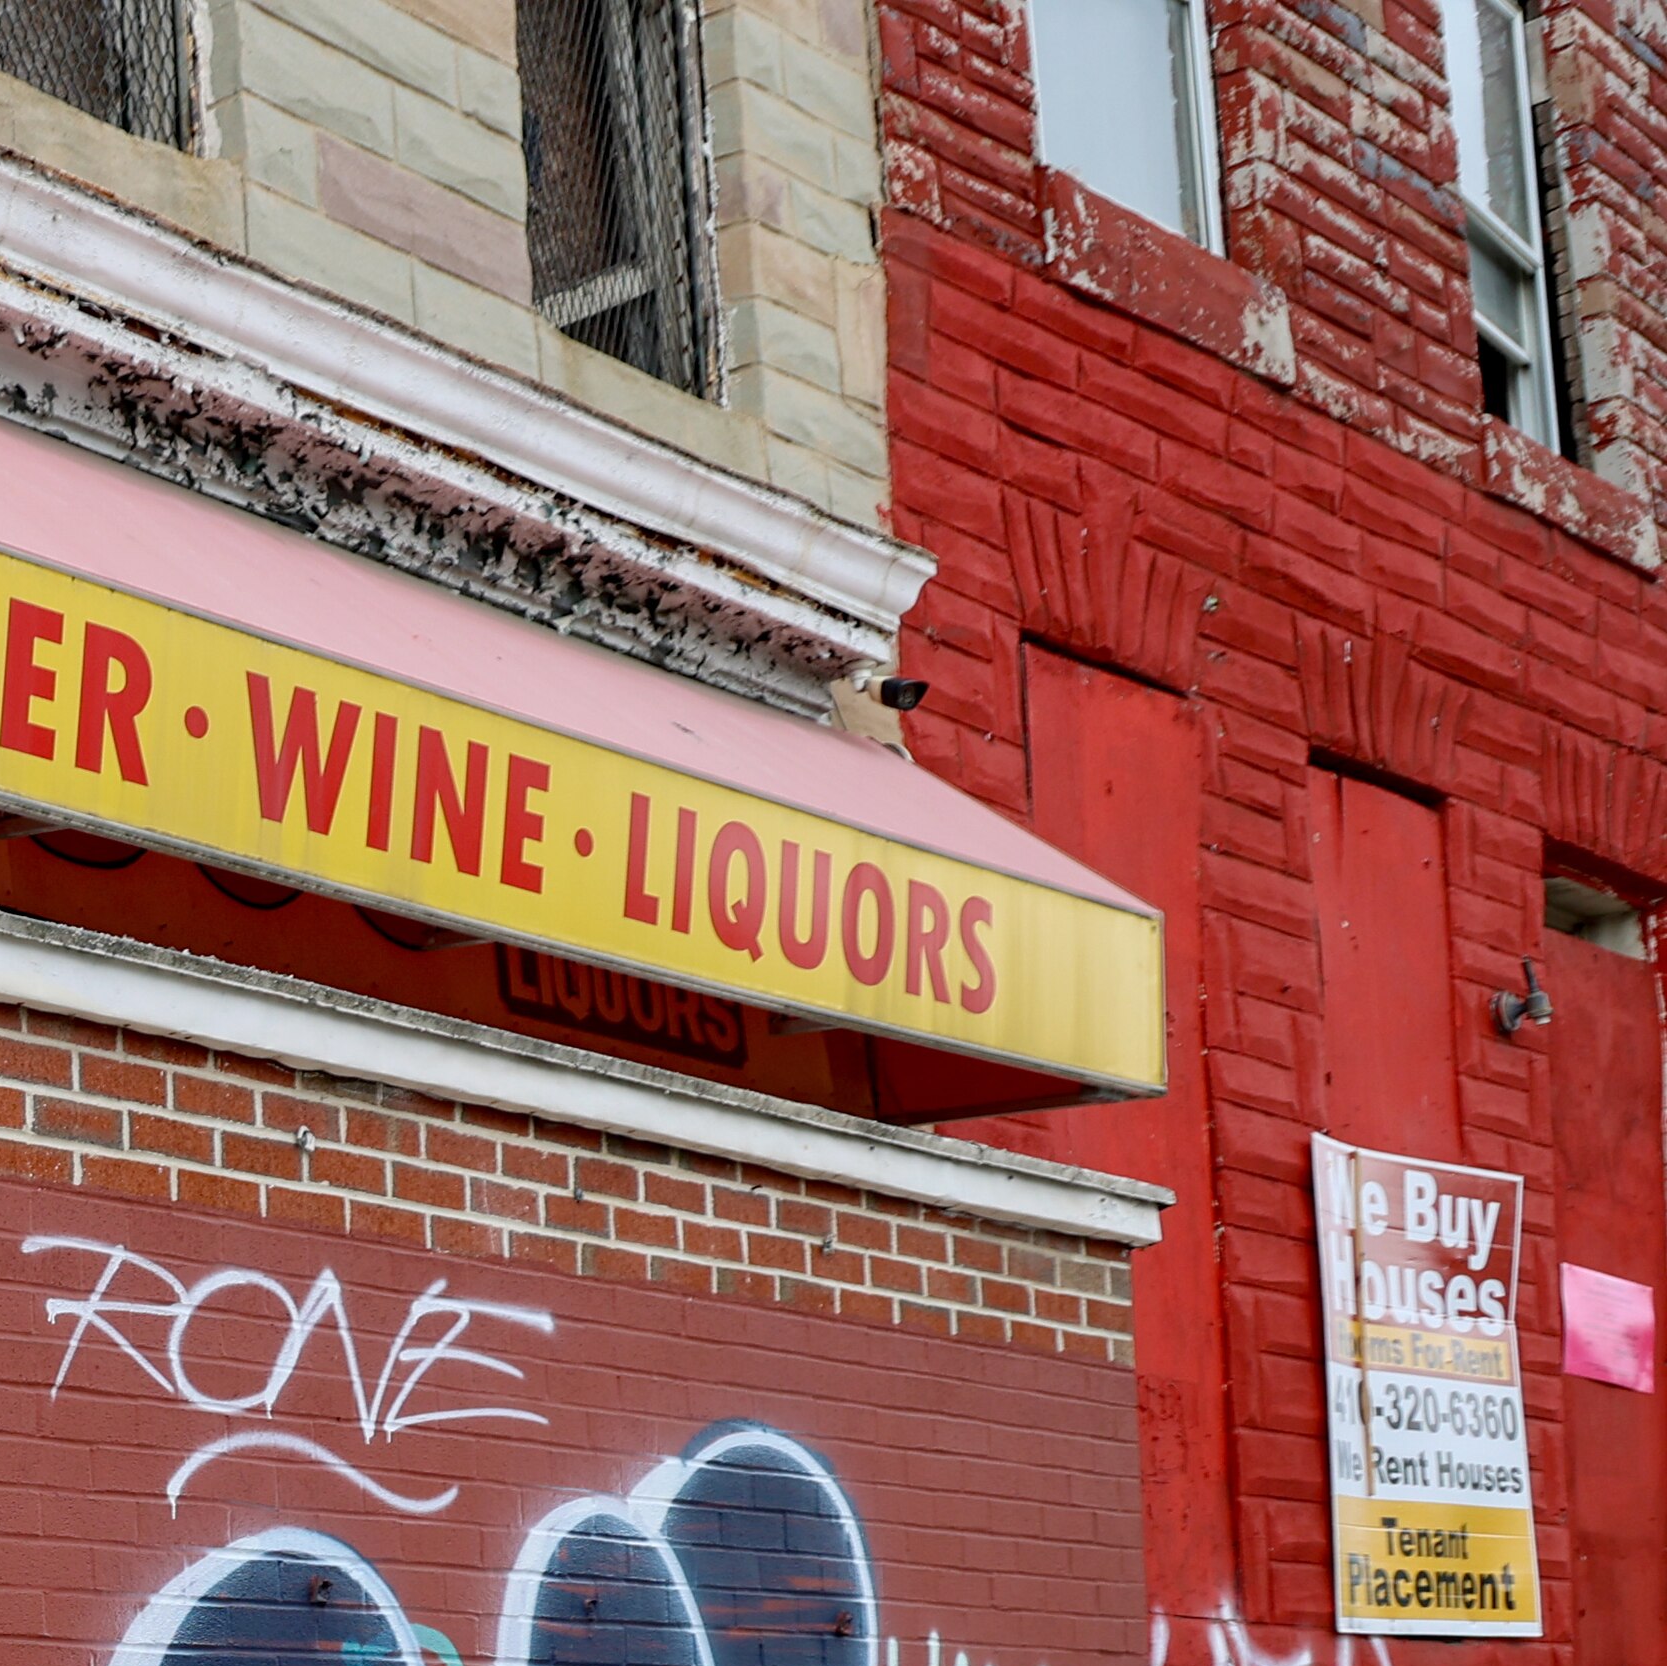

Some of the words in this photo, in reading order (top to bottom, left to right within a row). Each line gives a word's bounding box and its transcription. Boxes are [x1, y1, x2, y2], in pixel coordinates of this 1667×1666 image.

[246, 670, 552, 895] WINE
[622, 791, 997, 1015] LIQUORS
[1326, 1150, 1390, 1237] We
[1403, 1168, 1502, 1272] Buy
[1327, 1230, 1507, 1337] Houses
[1409, 1332, 1447, 1371] For
[1450, 1338, 1505, 1379] Rent
[1334, 1438, 1364, 1482] We
[1370, 1445, 1430, 1487] Rent
[1435, 1450, 1525, 1495] Houses
[1380, 1516, 1470, 1560] Tenant
[1347, 1552, 1517, 1612] Placement
